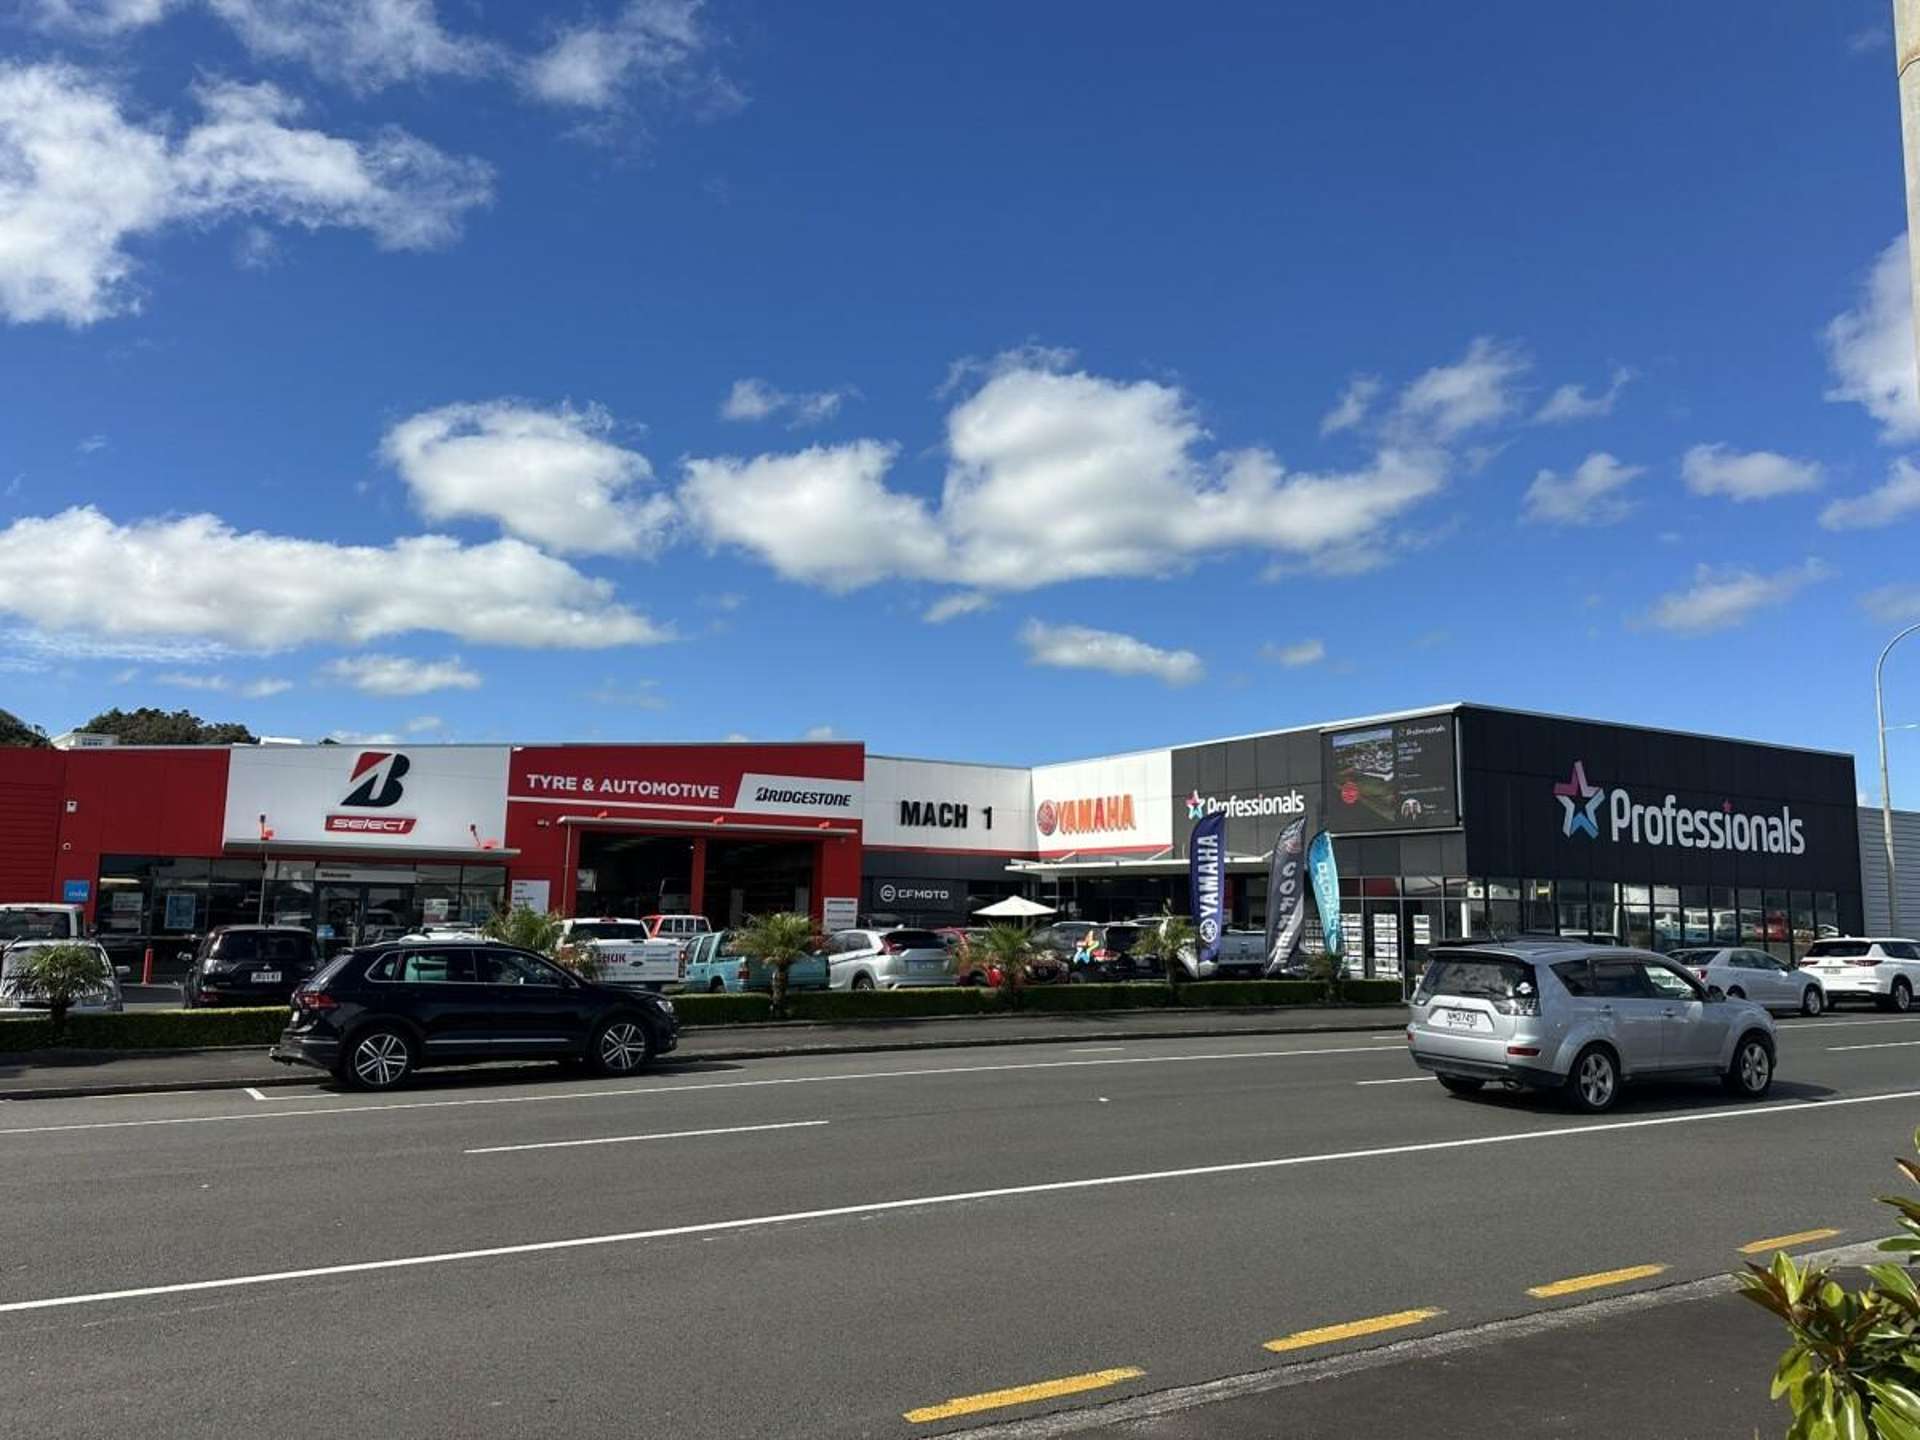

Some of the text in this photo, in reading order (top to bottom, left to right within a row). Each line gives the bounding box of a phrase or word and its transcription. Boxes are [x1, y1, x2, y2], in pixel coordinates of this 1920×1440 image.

[527, 774, 720, 799] TYRE & AUTOMOTIVE
[755, 787, 852, 807] BRIDGESTONE
[900, 800, 993, 830] MACH 1
[1056, 794, 1137, 834] YAMAHA
[1207, 789, 1305, 819] Professionals
[1610, 788, 1806, 855] Professionals
[1197, 834, 1219, 917] YAMAHA
[898, 888, 949, 900] CFMOTO
